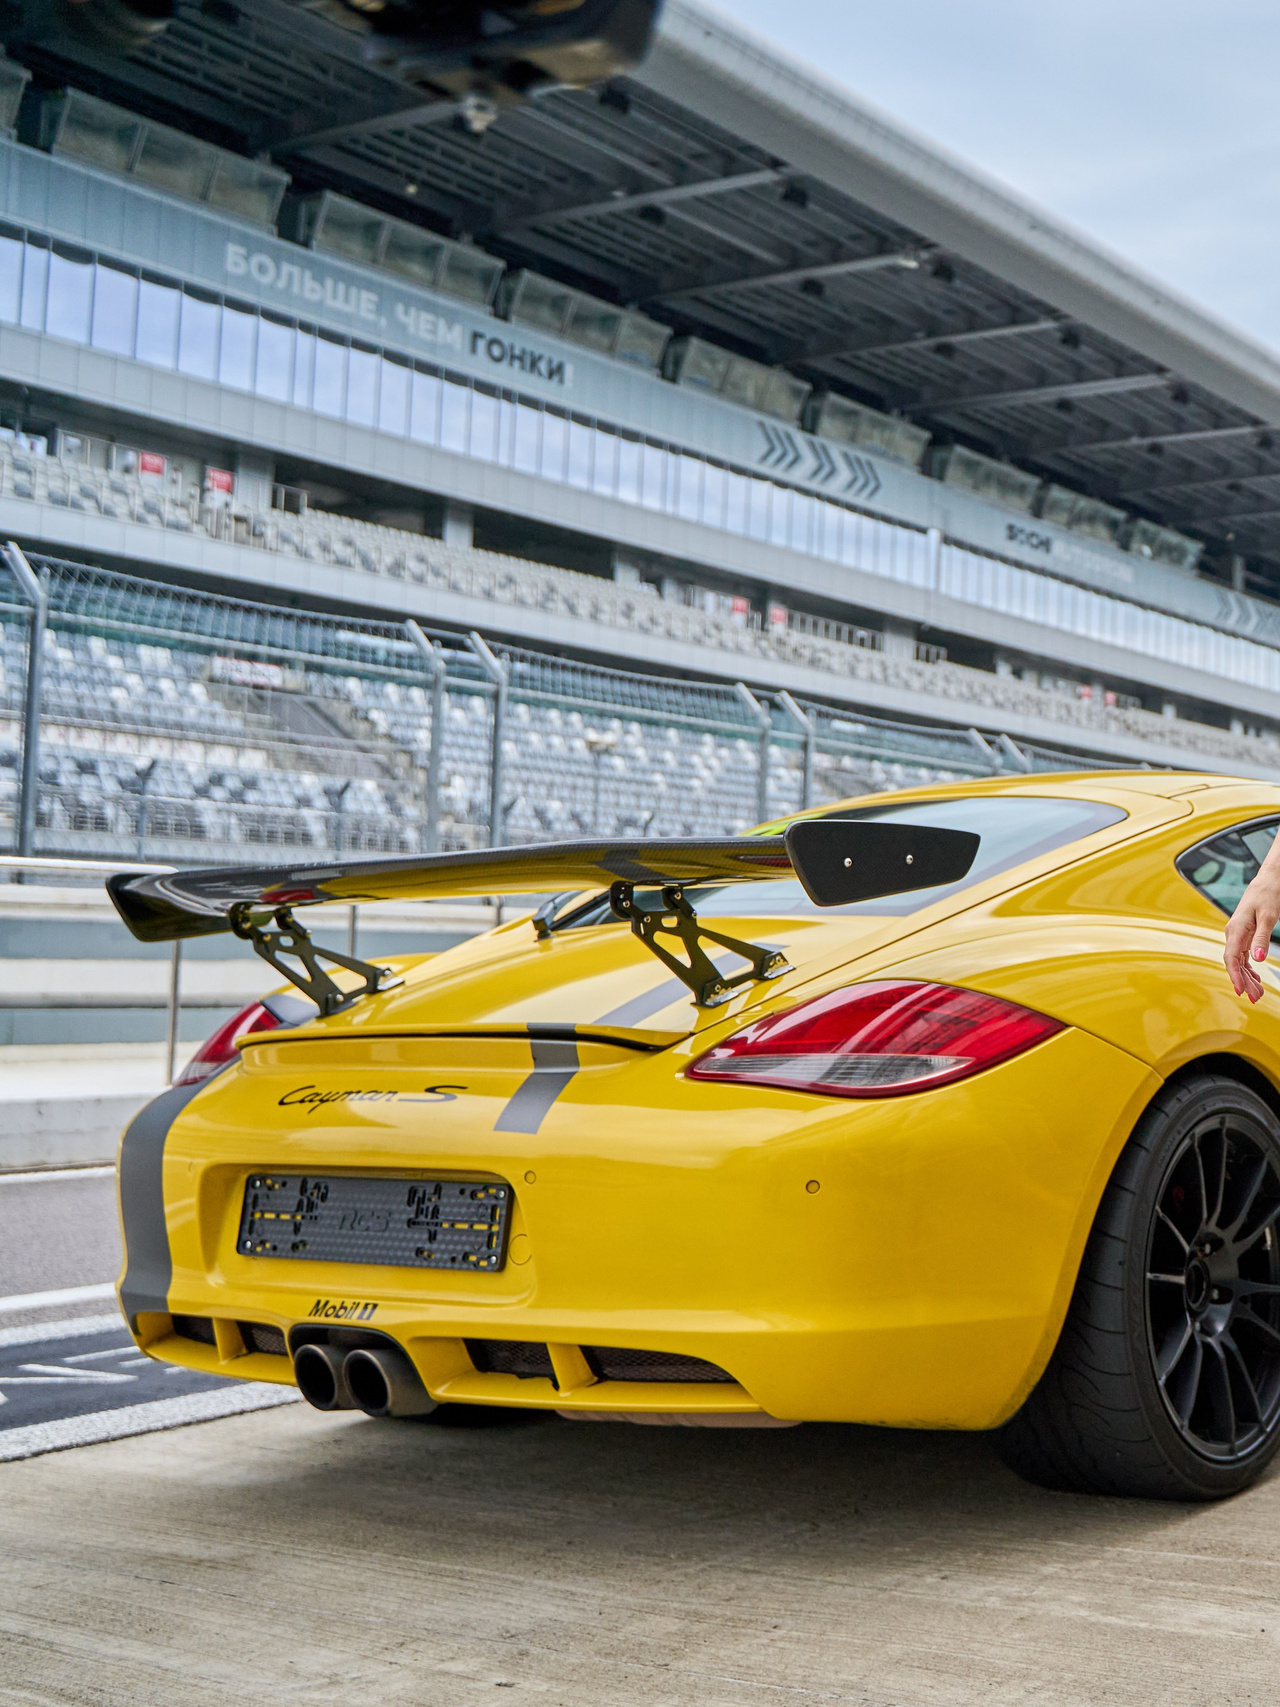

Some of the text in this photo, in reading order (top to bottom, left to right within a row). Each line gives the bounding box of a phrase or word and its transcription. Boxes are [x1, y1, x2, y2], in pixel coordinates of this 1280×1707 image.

[224, 242, 565, 385] БОЛЬШЕ, ЧЕМ ГОНКИ
[278, 1085, 468, 1115] Cayman S
[308, 1299, 378, 1321] Mobil 1
